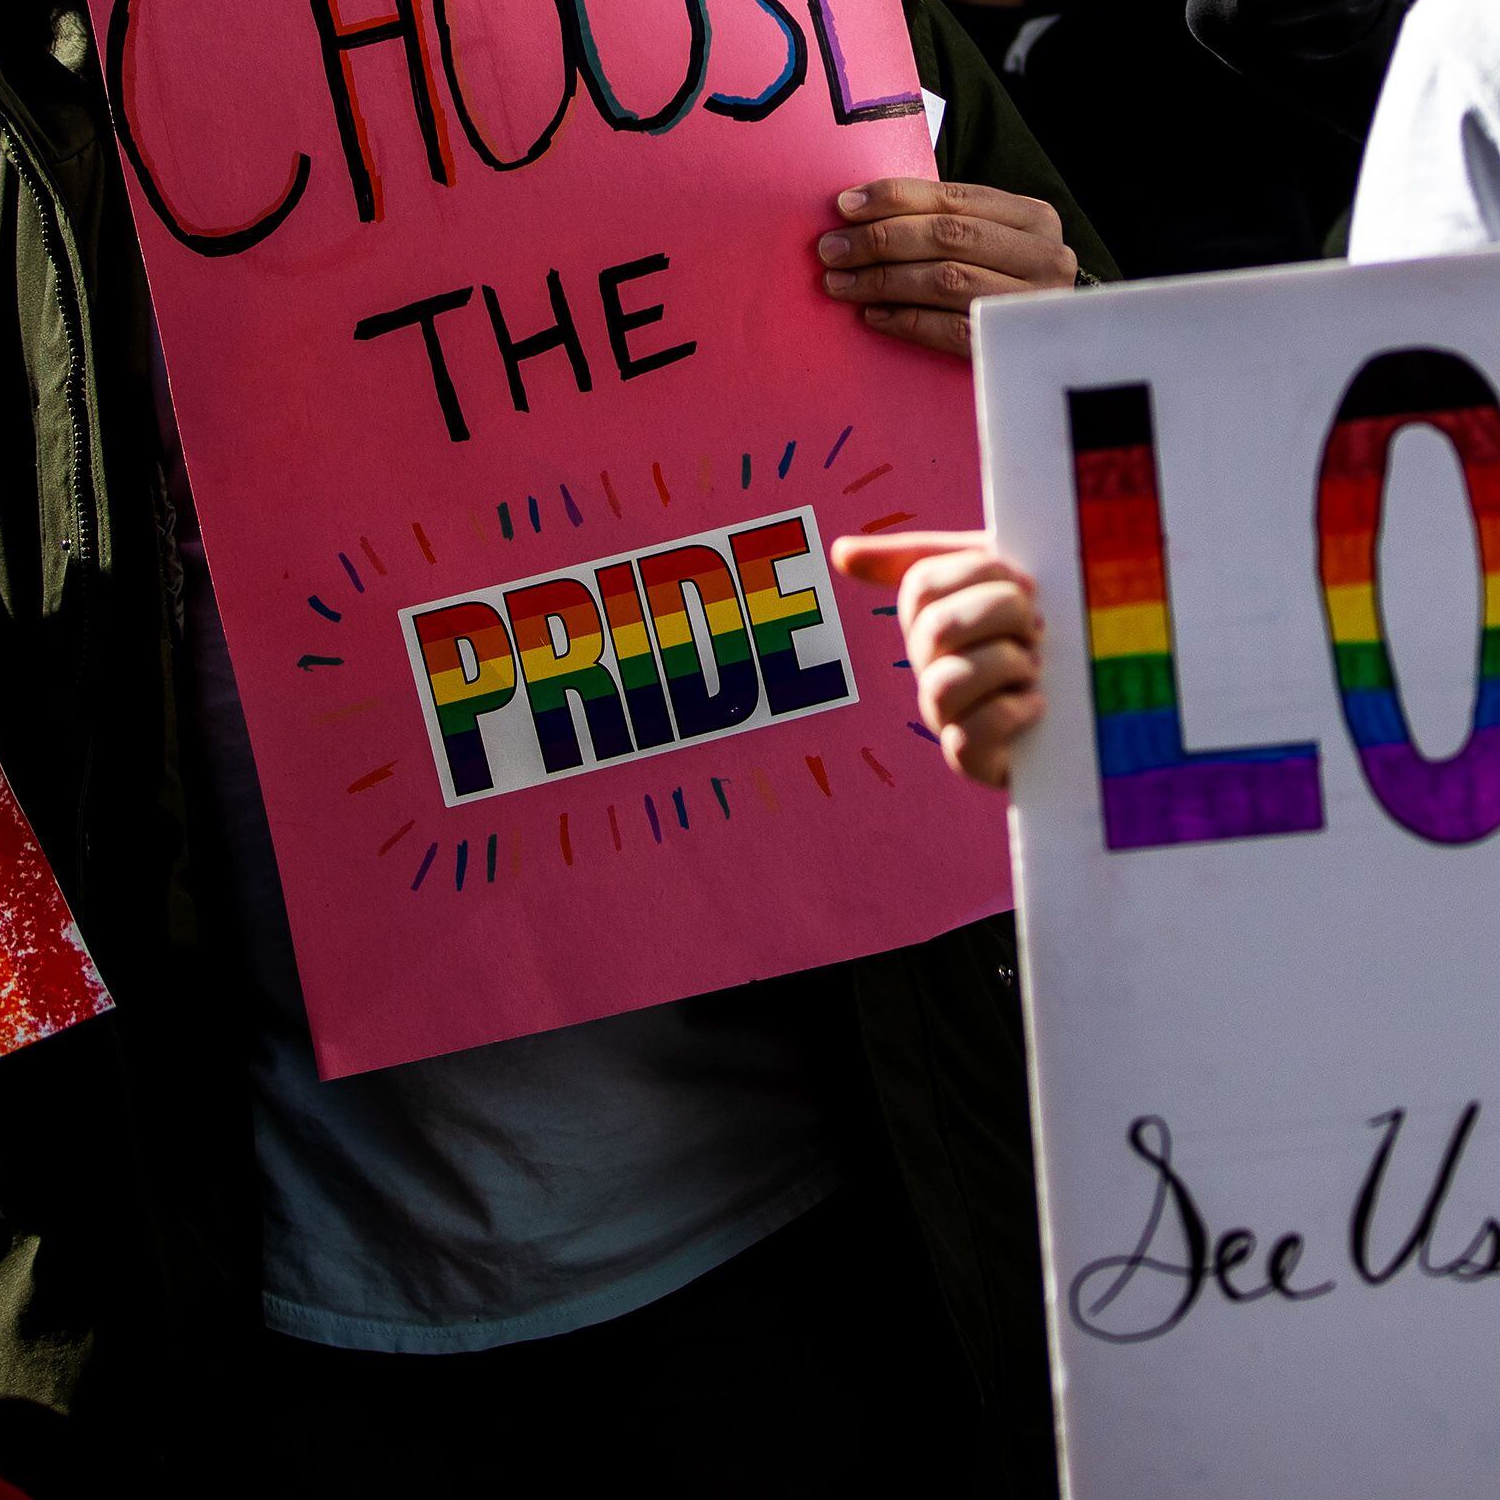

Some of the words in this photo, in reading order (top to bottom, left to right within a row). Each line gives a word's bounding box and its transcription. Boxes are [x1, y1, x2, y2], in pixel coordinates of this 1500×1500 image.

[352, 252, 698, 443] THE
[410, 516, 849, 798] PRIDE
[1068, 1113, 1337, 1346] See
